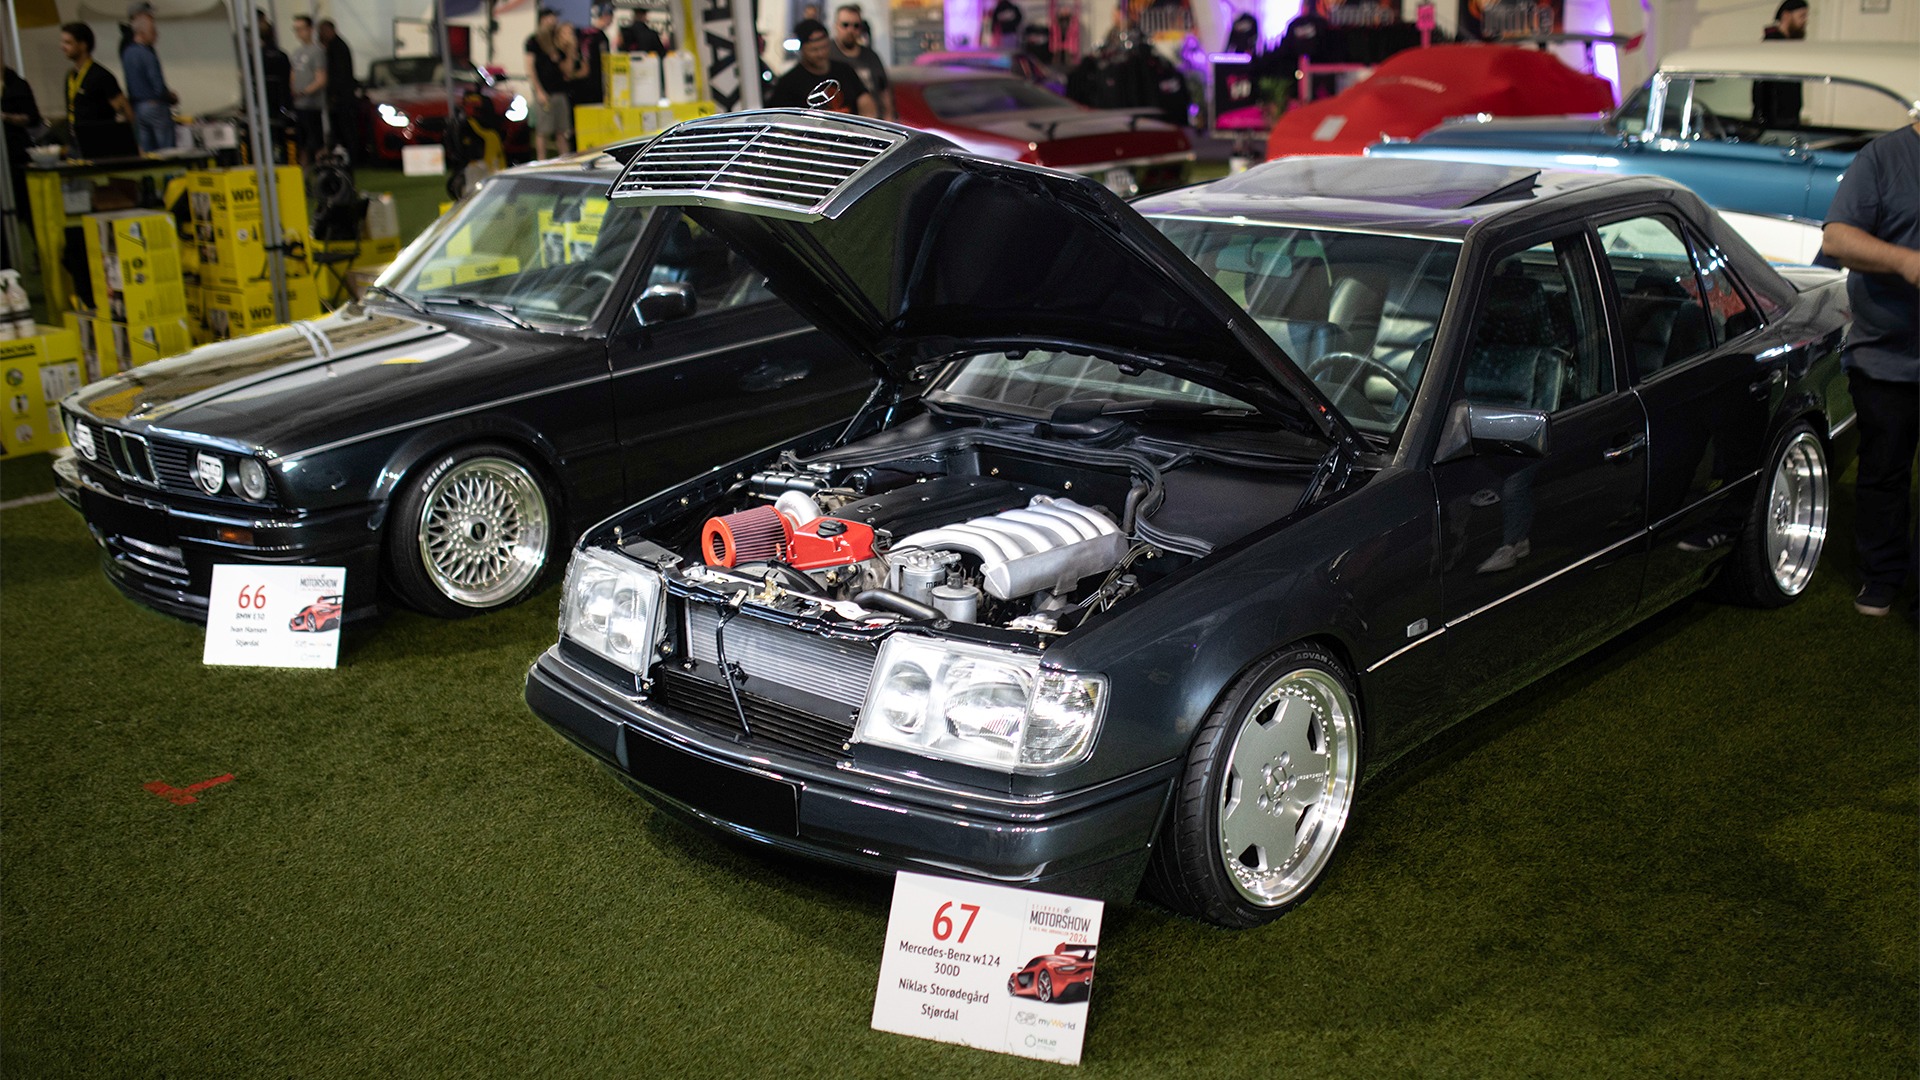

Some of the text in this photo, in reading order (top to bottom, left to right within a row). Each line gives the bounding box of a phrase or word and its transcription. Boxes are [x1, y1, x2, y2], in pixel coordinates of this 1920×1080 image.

[238, 584, 266, 609] 66
[1297, 652, 1328, 662] ADVAN
[932, 901, 981, 944] 67
[1030, 911, 1091, 932] MOTORSHOW
[1069, 932, 1088, 943] 2024
[899, 941, 1001, 967] Mercedes-Benz w124
[934, 962, 960, 977] 300D
[898, 978, 989, 1004] Niklas Storødegård
[921, 1004, 959, 1021] Stjørdal
